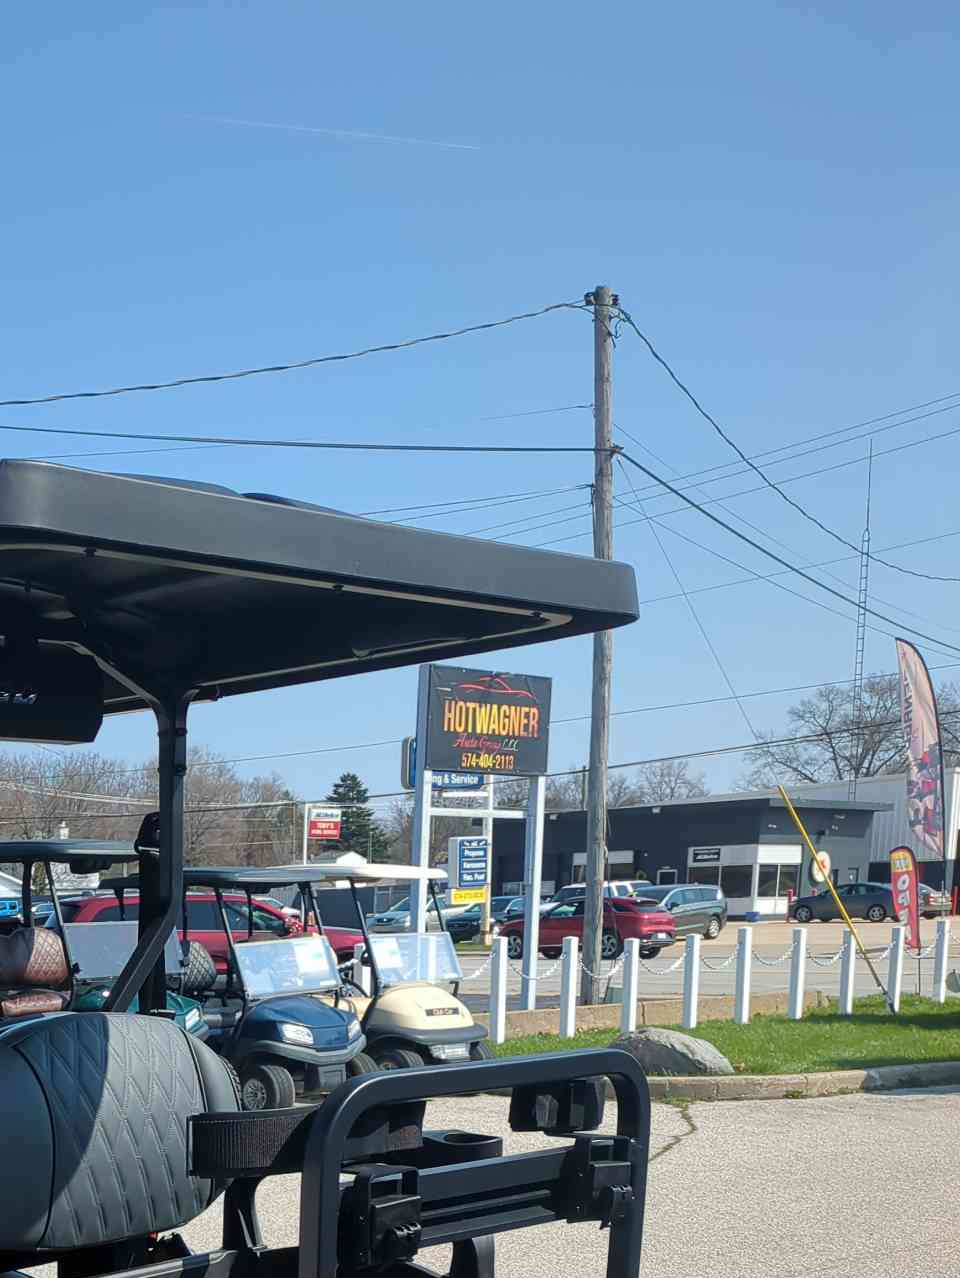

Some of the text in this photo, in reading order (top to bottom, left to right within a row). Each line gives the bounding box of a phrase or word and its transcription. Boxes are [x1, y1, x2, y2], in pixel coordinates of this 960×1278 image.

[444, 700, 540, 738] HOTWAGNER
[461, 752, 515, 769] 574-404-2113
[451, 774, 479, 785] Service
